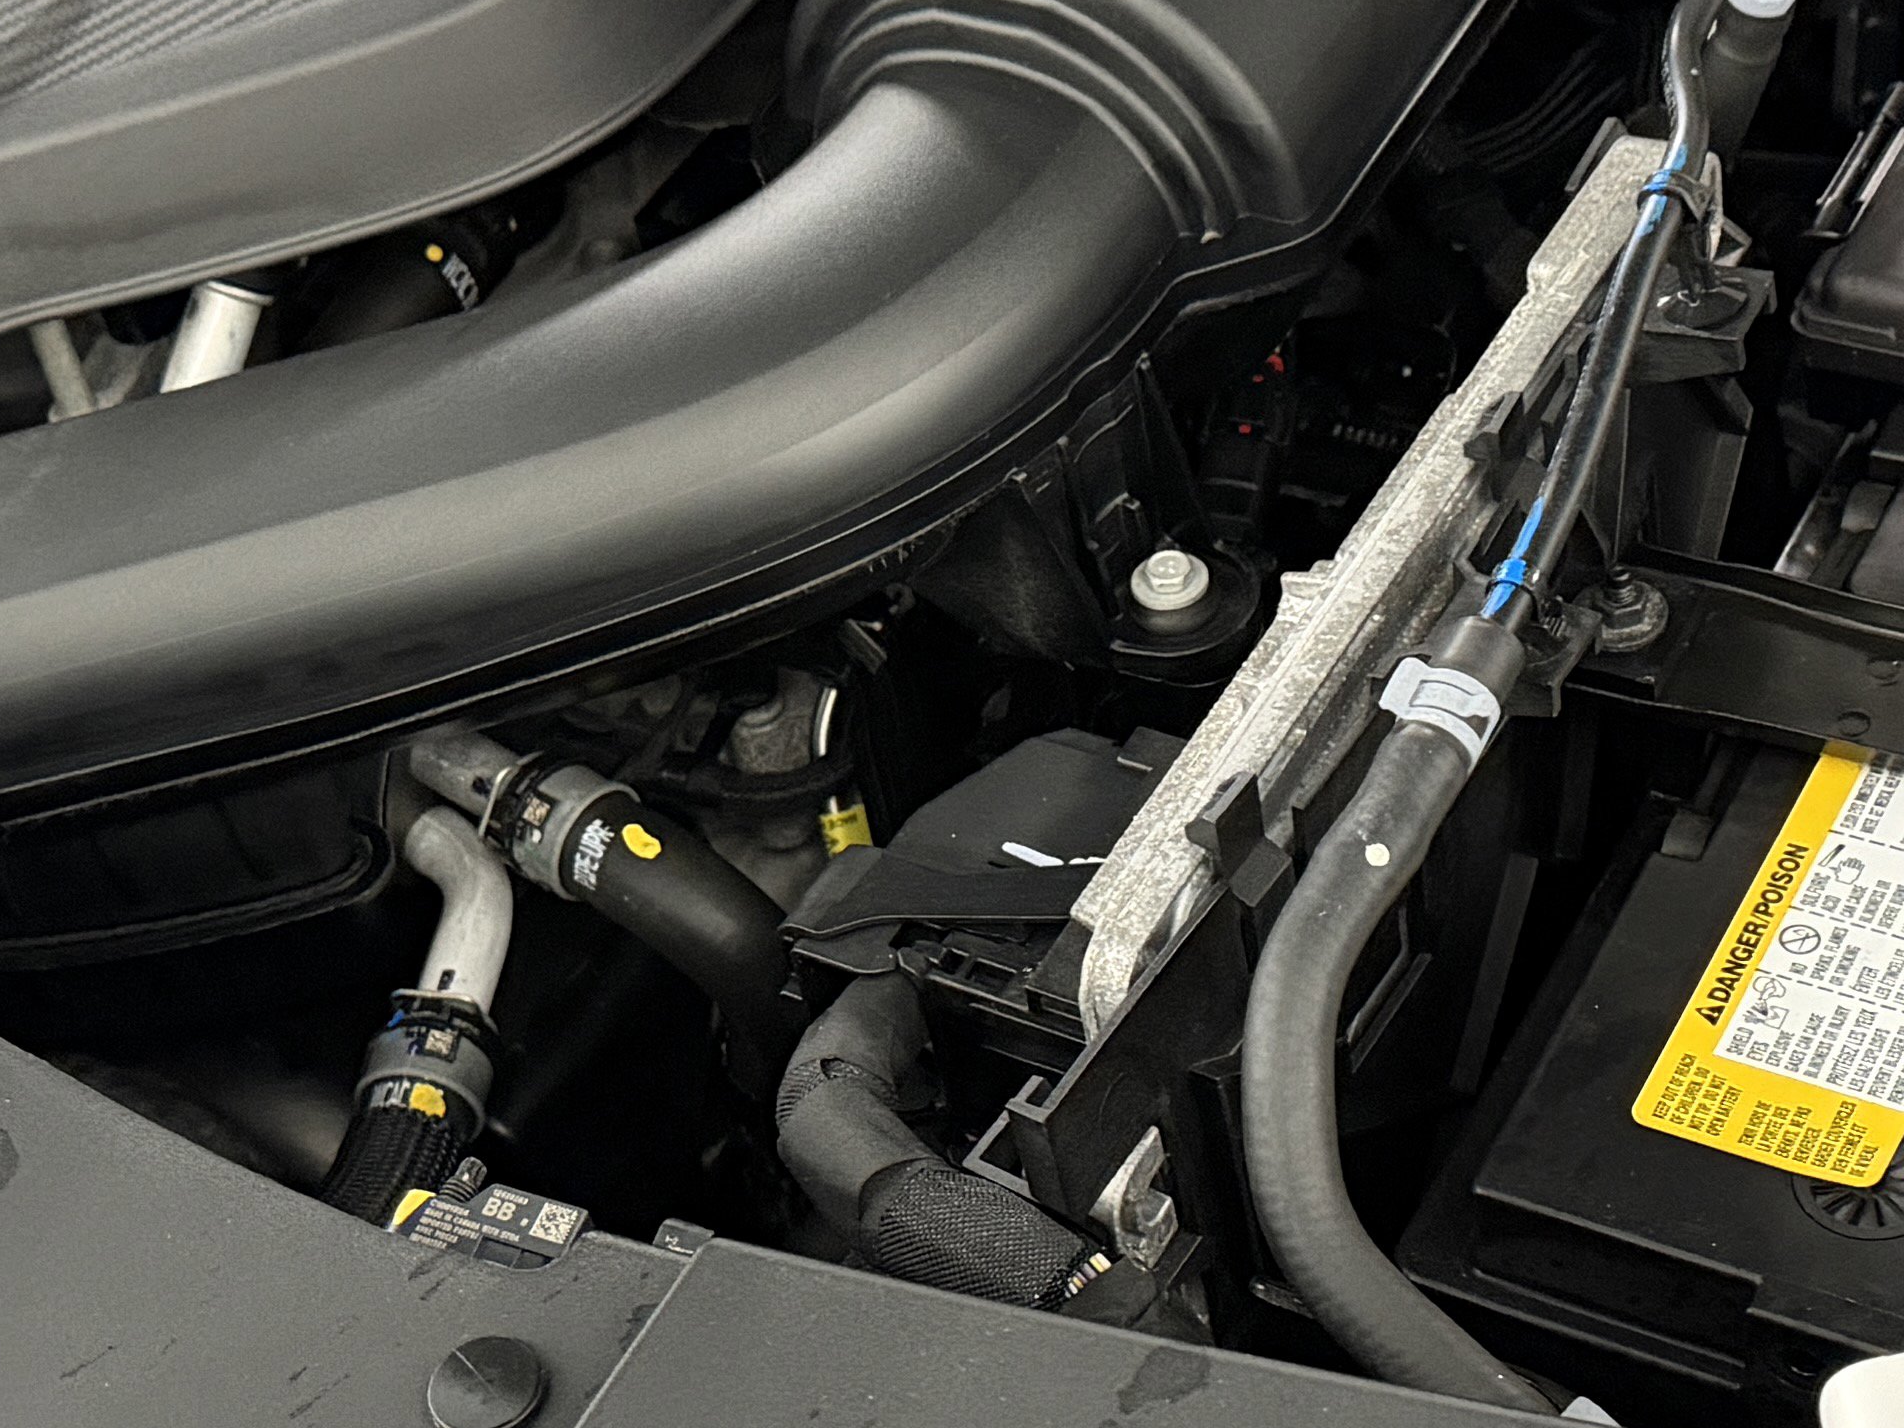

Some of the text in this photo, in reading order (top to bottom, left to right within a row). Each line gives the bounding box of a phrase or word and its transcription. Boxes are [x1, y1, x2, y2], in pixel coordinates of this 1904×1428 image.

[1705, 841, 1809, 1004] DANGER/POISON
[1724, 1025, 1755, 1056] SHIELD
[482, 1197, 516, 1221] BB
